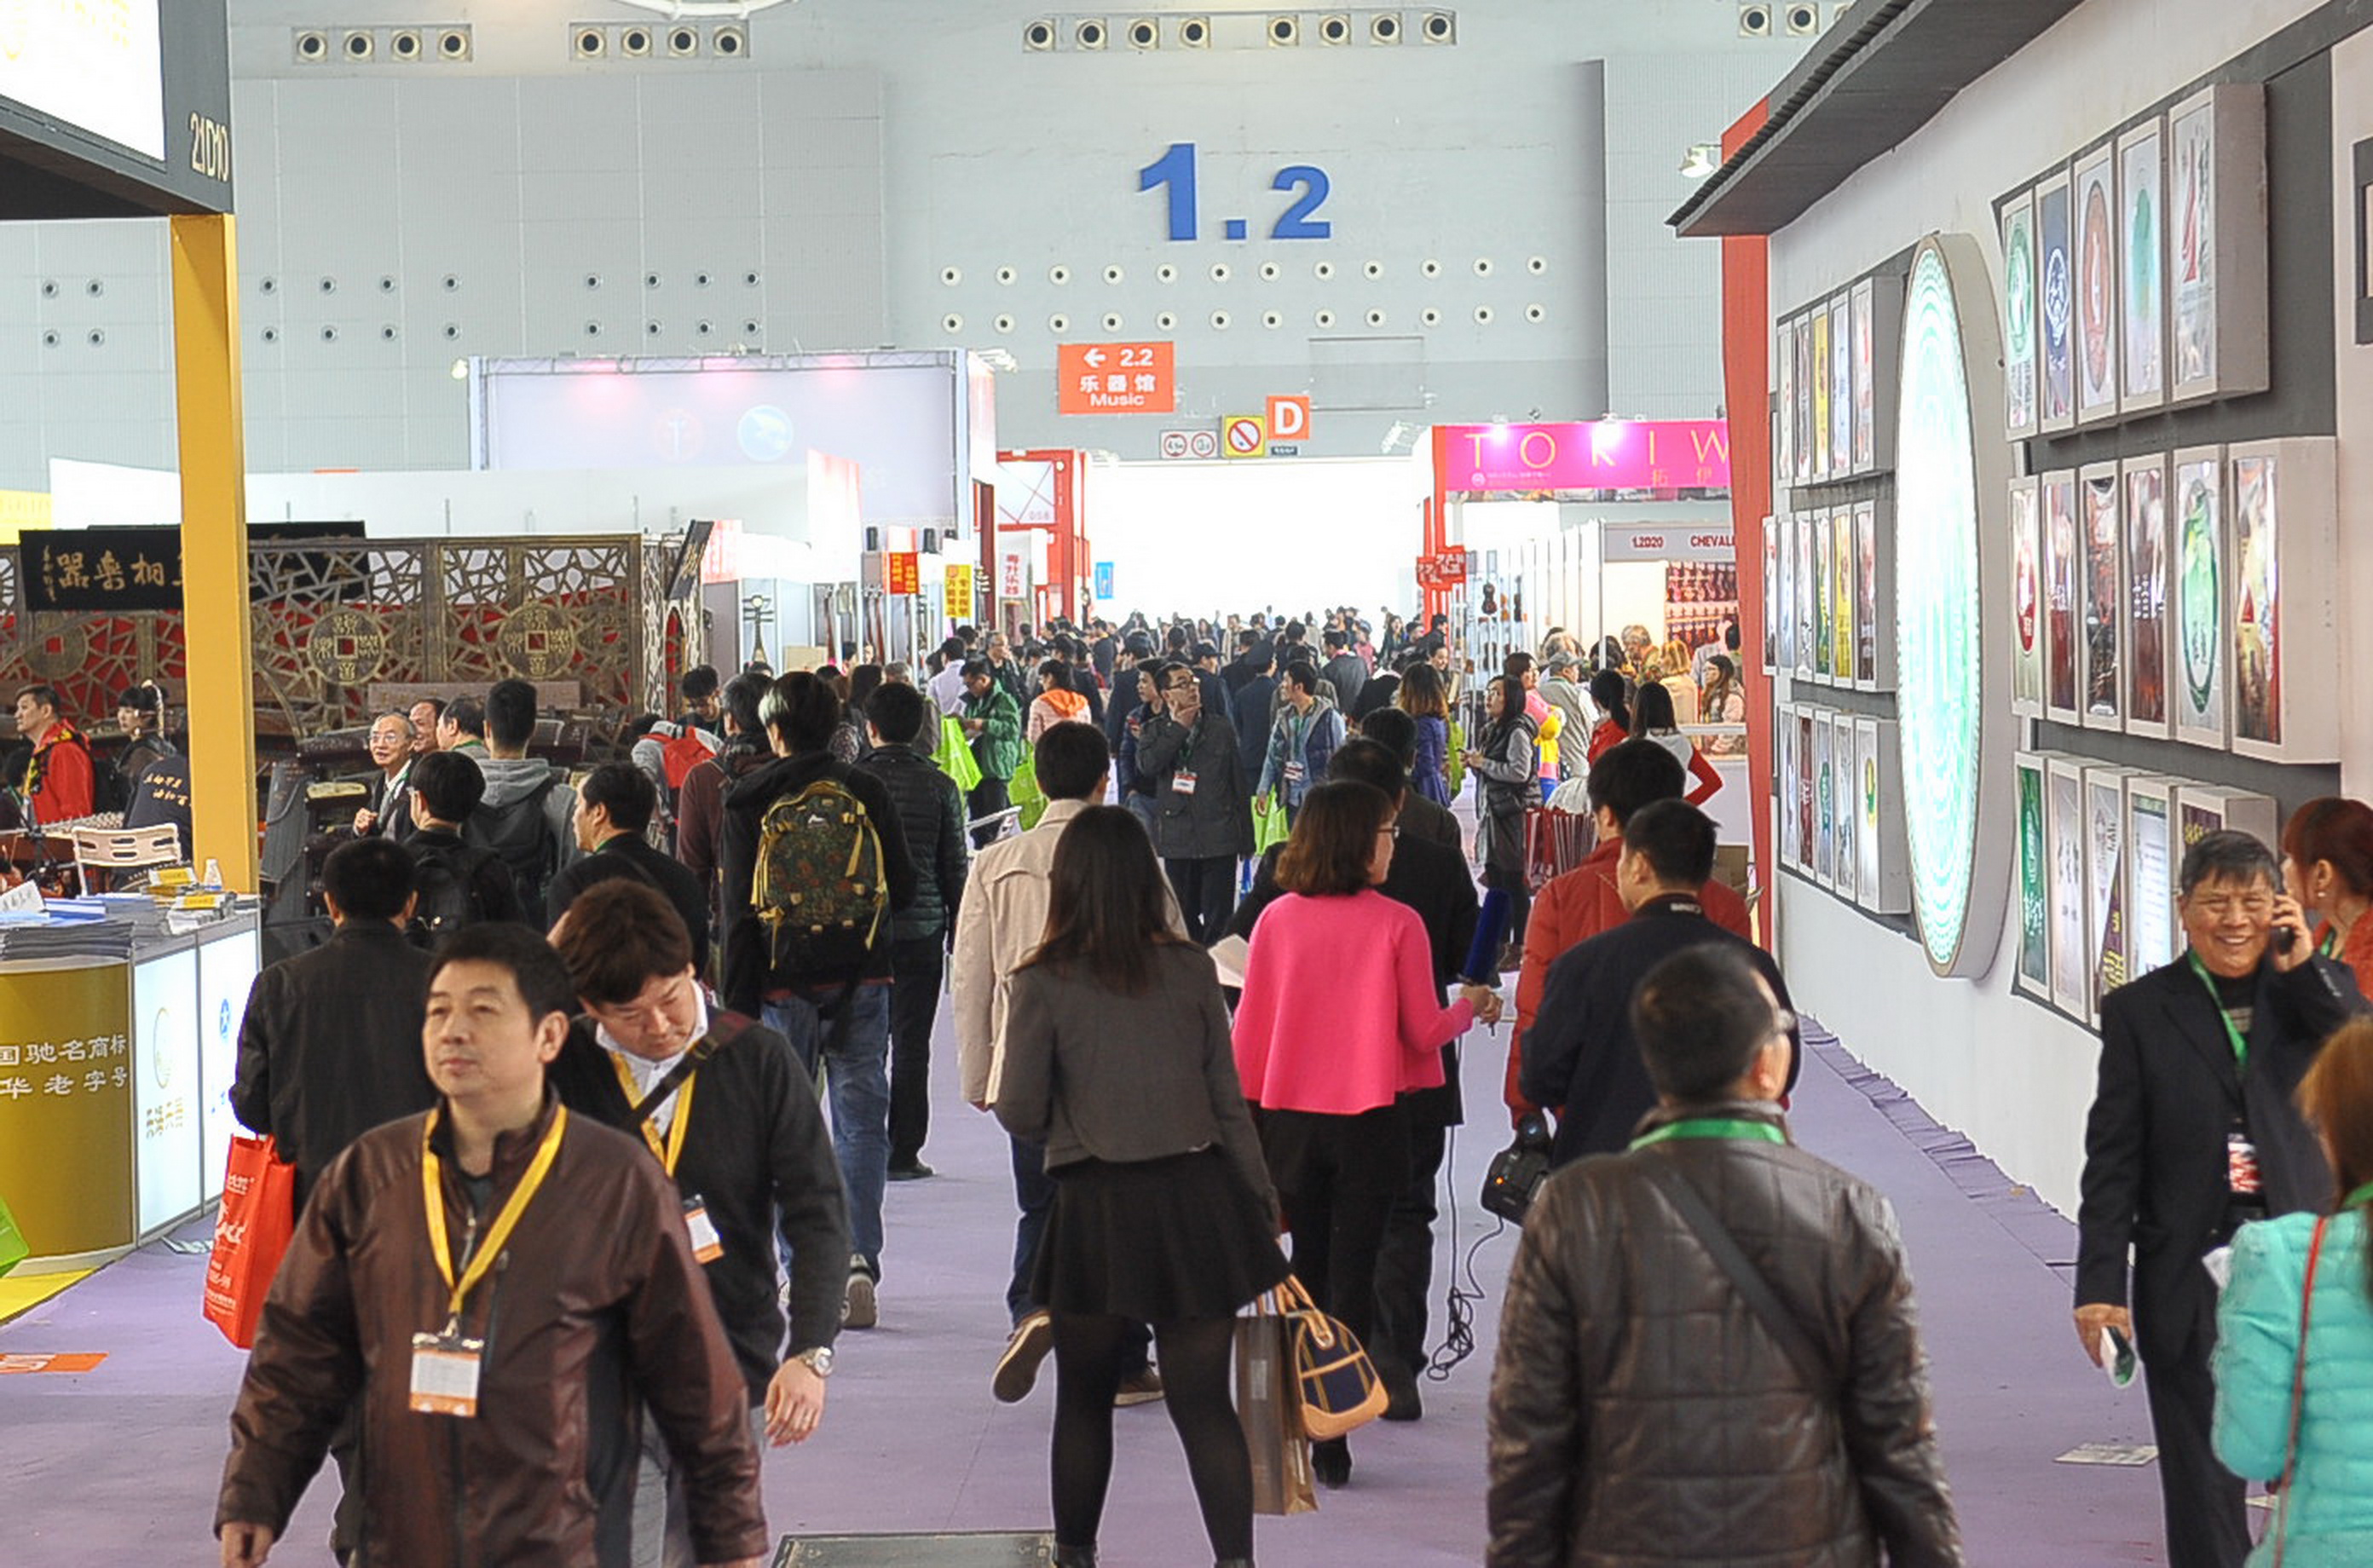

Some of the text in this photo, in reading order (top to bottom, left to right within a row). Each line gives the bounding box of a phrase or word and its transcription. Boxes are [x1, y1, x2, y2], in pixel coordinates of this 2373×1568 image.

[1137, 142, 1332, 241] 1.2
[1119, 349, 1154, 367] 2.2
[1079, 373, 1157, 393] 乐器馆
[1089, 393, 1146, 407] Music
[1273, 401, 1303, 435] D
[0, 1065, 128, 1100] 华老字号
